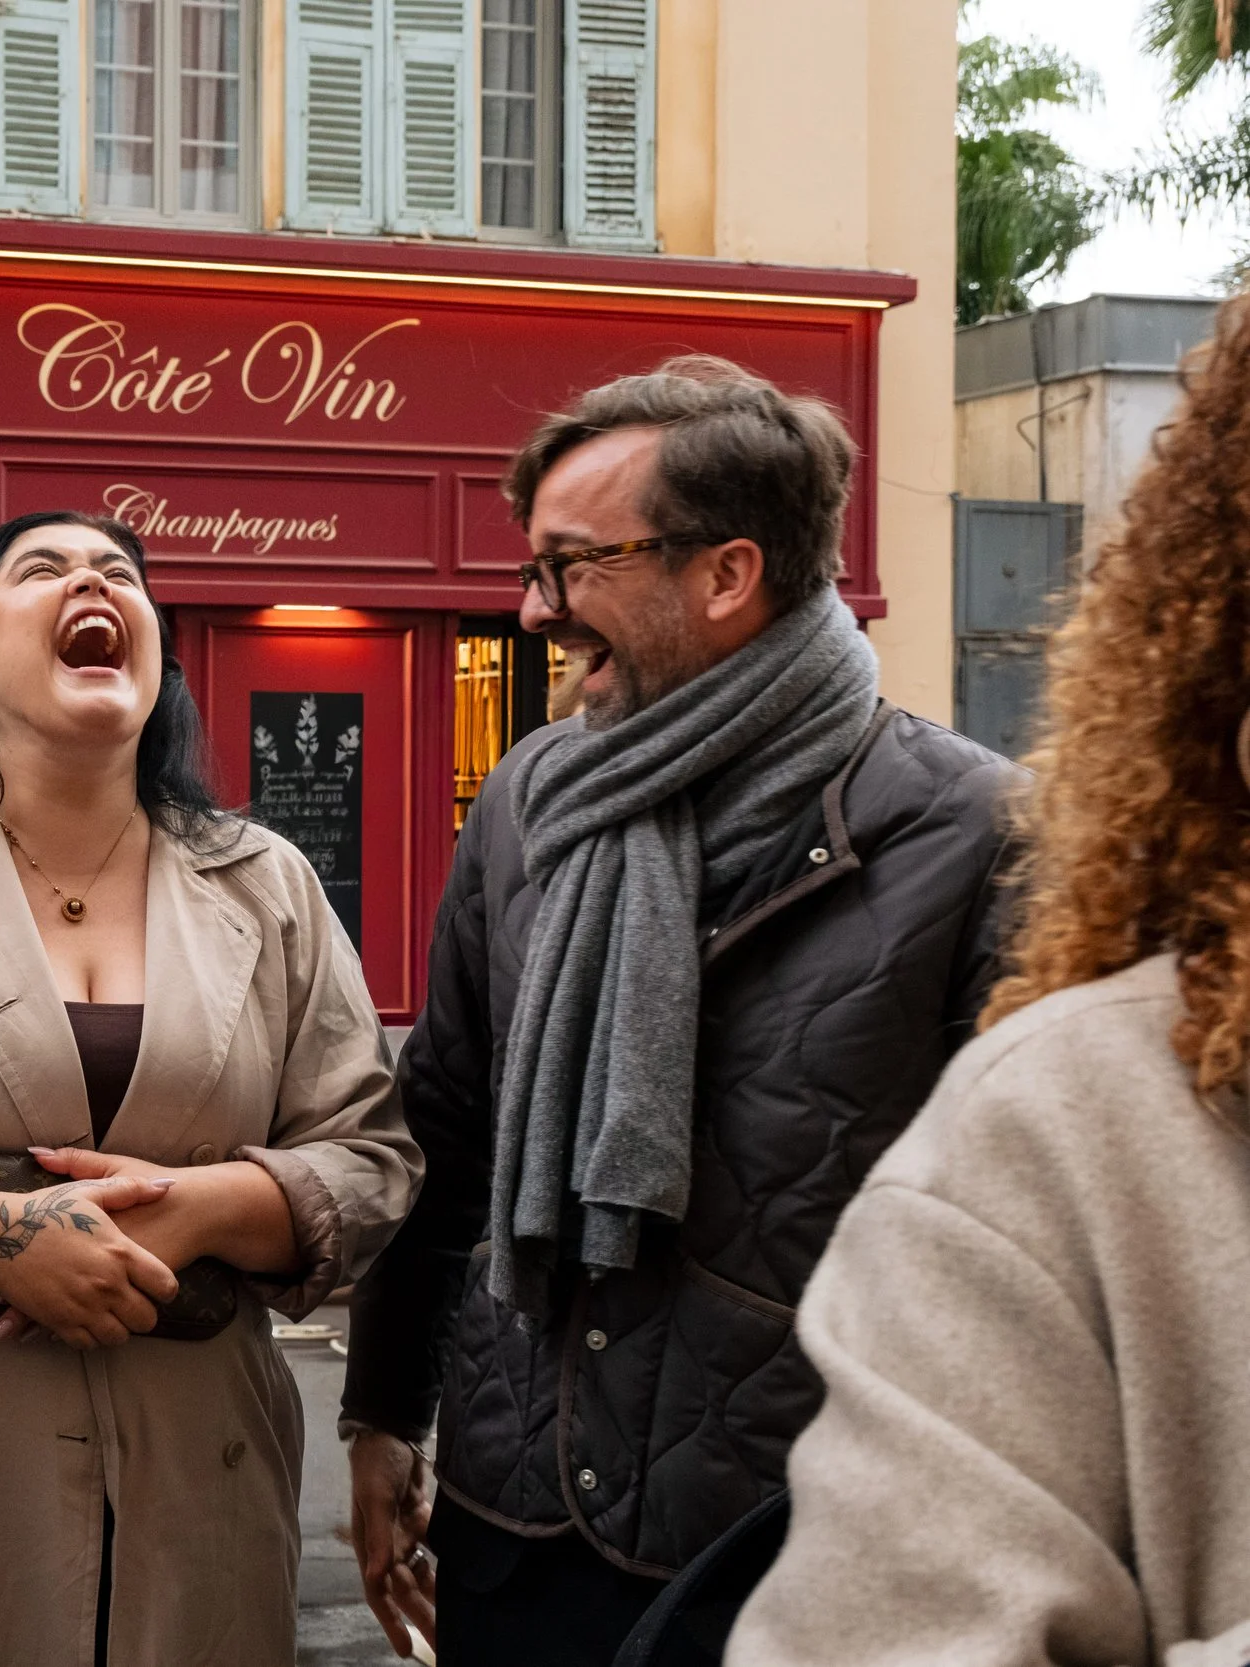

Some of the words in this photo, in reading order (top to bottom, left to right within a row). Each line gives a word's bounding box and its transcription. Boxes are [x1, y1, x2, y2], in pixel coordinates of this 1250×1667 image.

[17, 303, 231, 414] Côté
[241, 318, 421, 425] Vin
[102, 484, 338, 555] Champagnes
